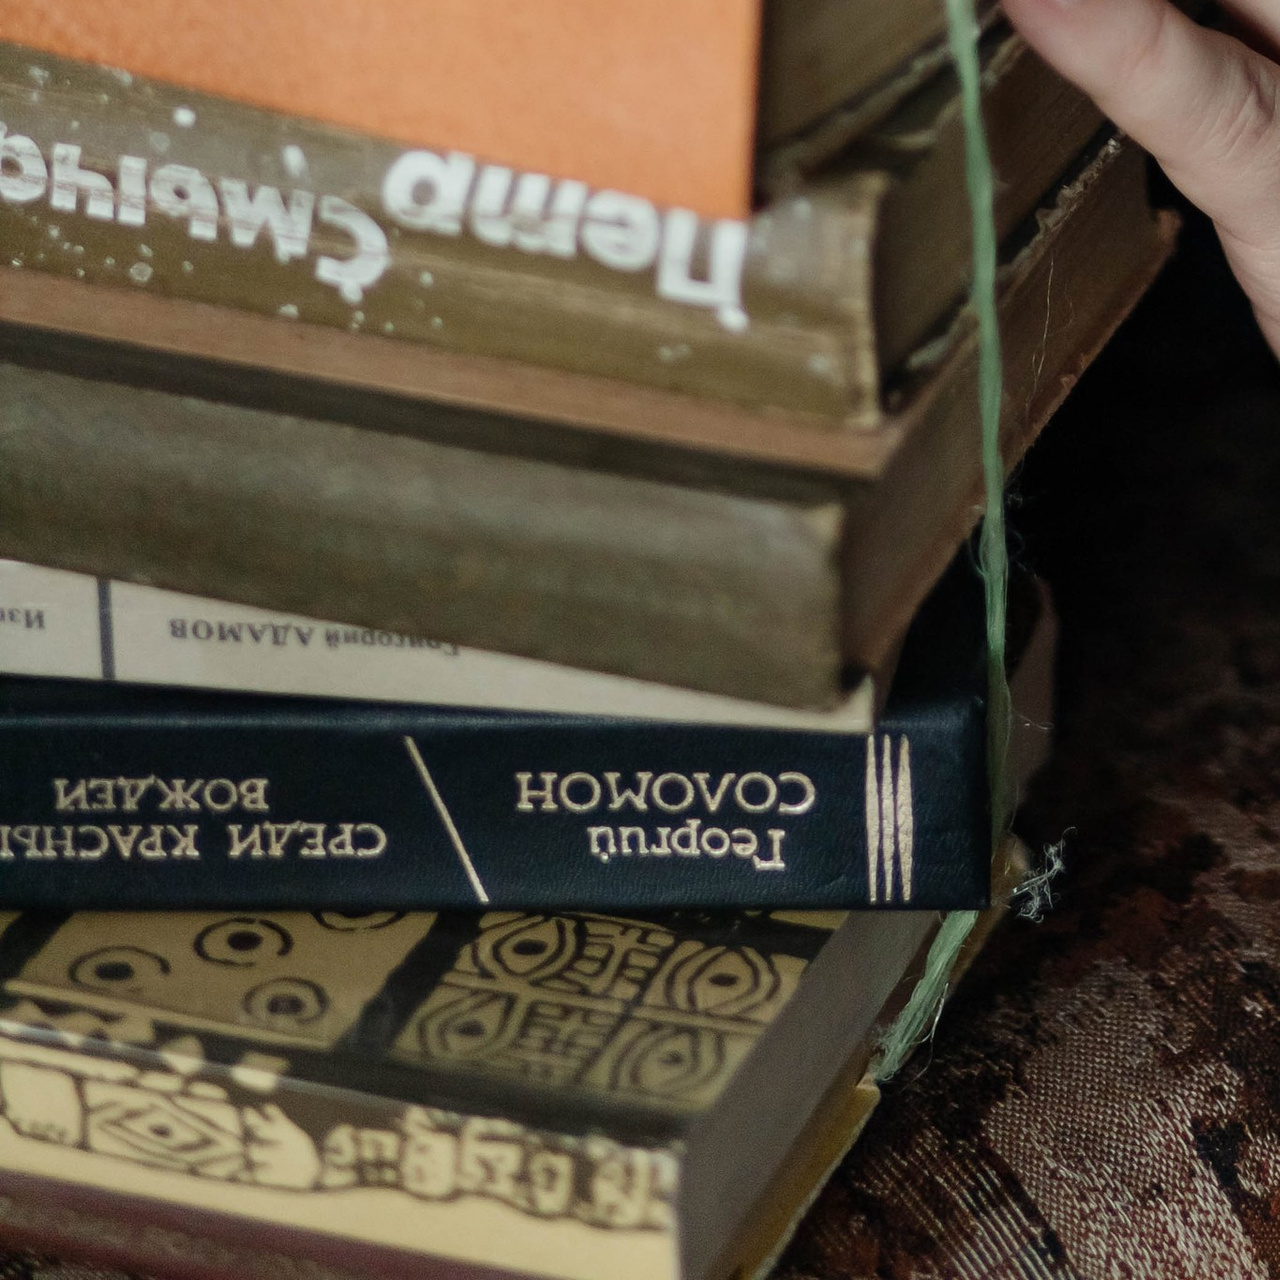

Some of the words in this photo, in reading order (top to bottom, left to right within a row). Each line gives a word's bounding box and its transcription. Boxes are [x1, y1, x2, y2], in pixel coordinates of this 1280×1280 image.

[0, 608, 46, 630] Из
[170, 618, 314, 648] АДАМОВ
[515, 771, 816, 815] СОЛОМОН
[228, 821, 388, 860] СРЕДИ
[587, 818, 787, 871] Георгий
